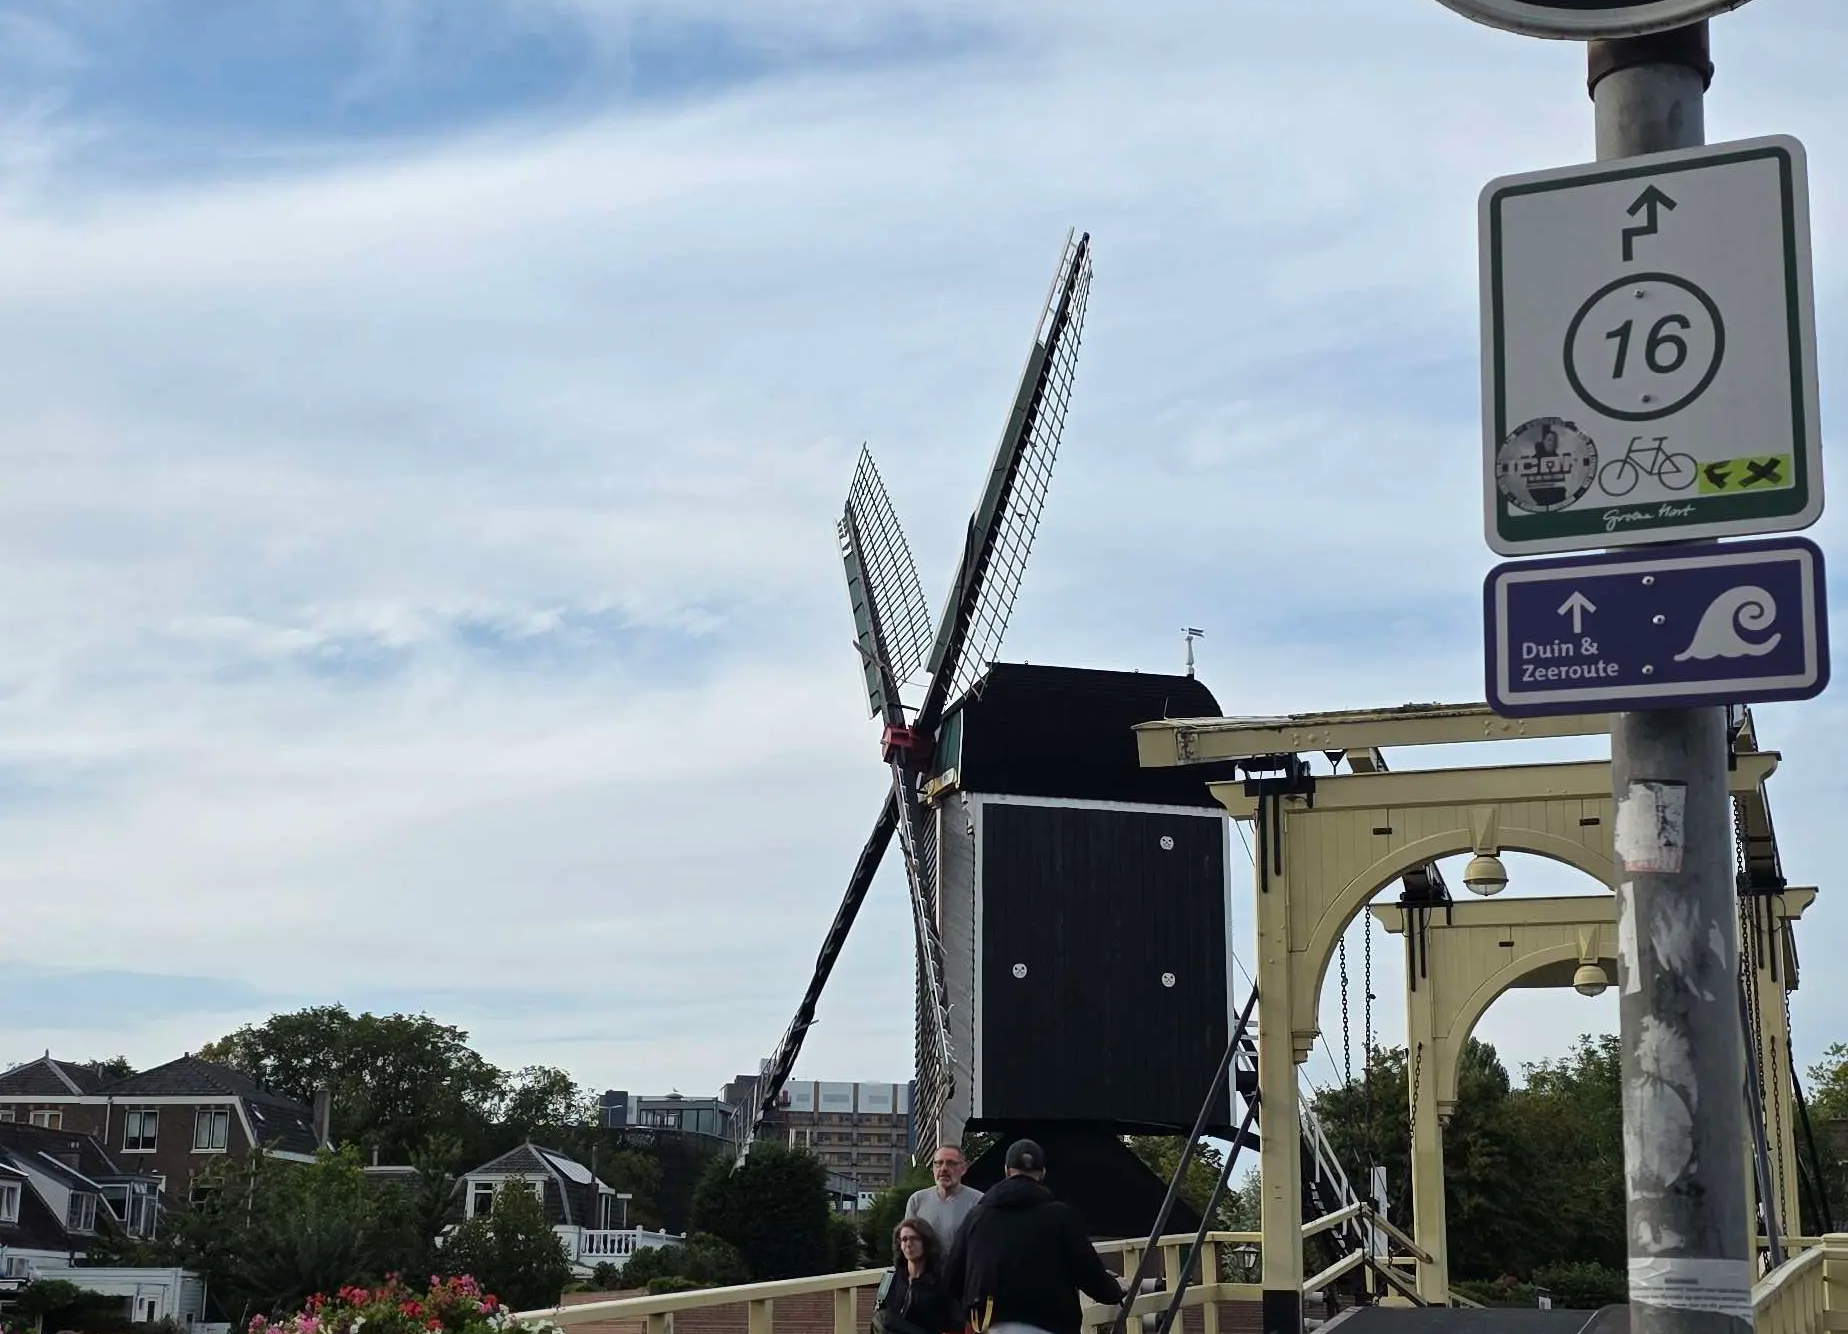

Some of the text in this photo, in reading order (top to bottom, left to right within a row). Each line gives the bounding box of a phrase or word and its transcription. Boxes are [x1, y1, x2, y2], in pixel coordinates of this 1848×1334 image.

[1605, 313, 1691, 379] 16
[1522, 637, 1599, 659] Duin &
[1522, 660, 1620, 682] Zeeroute
